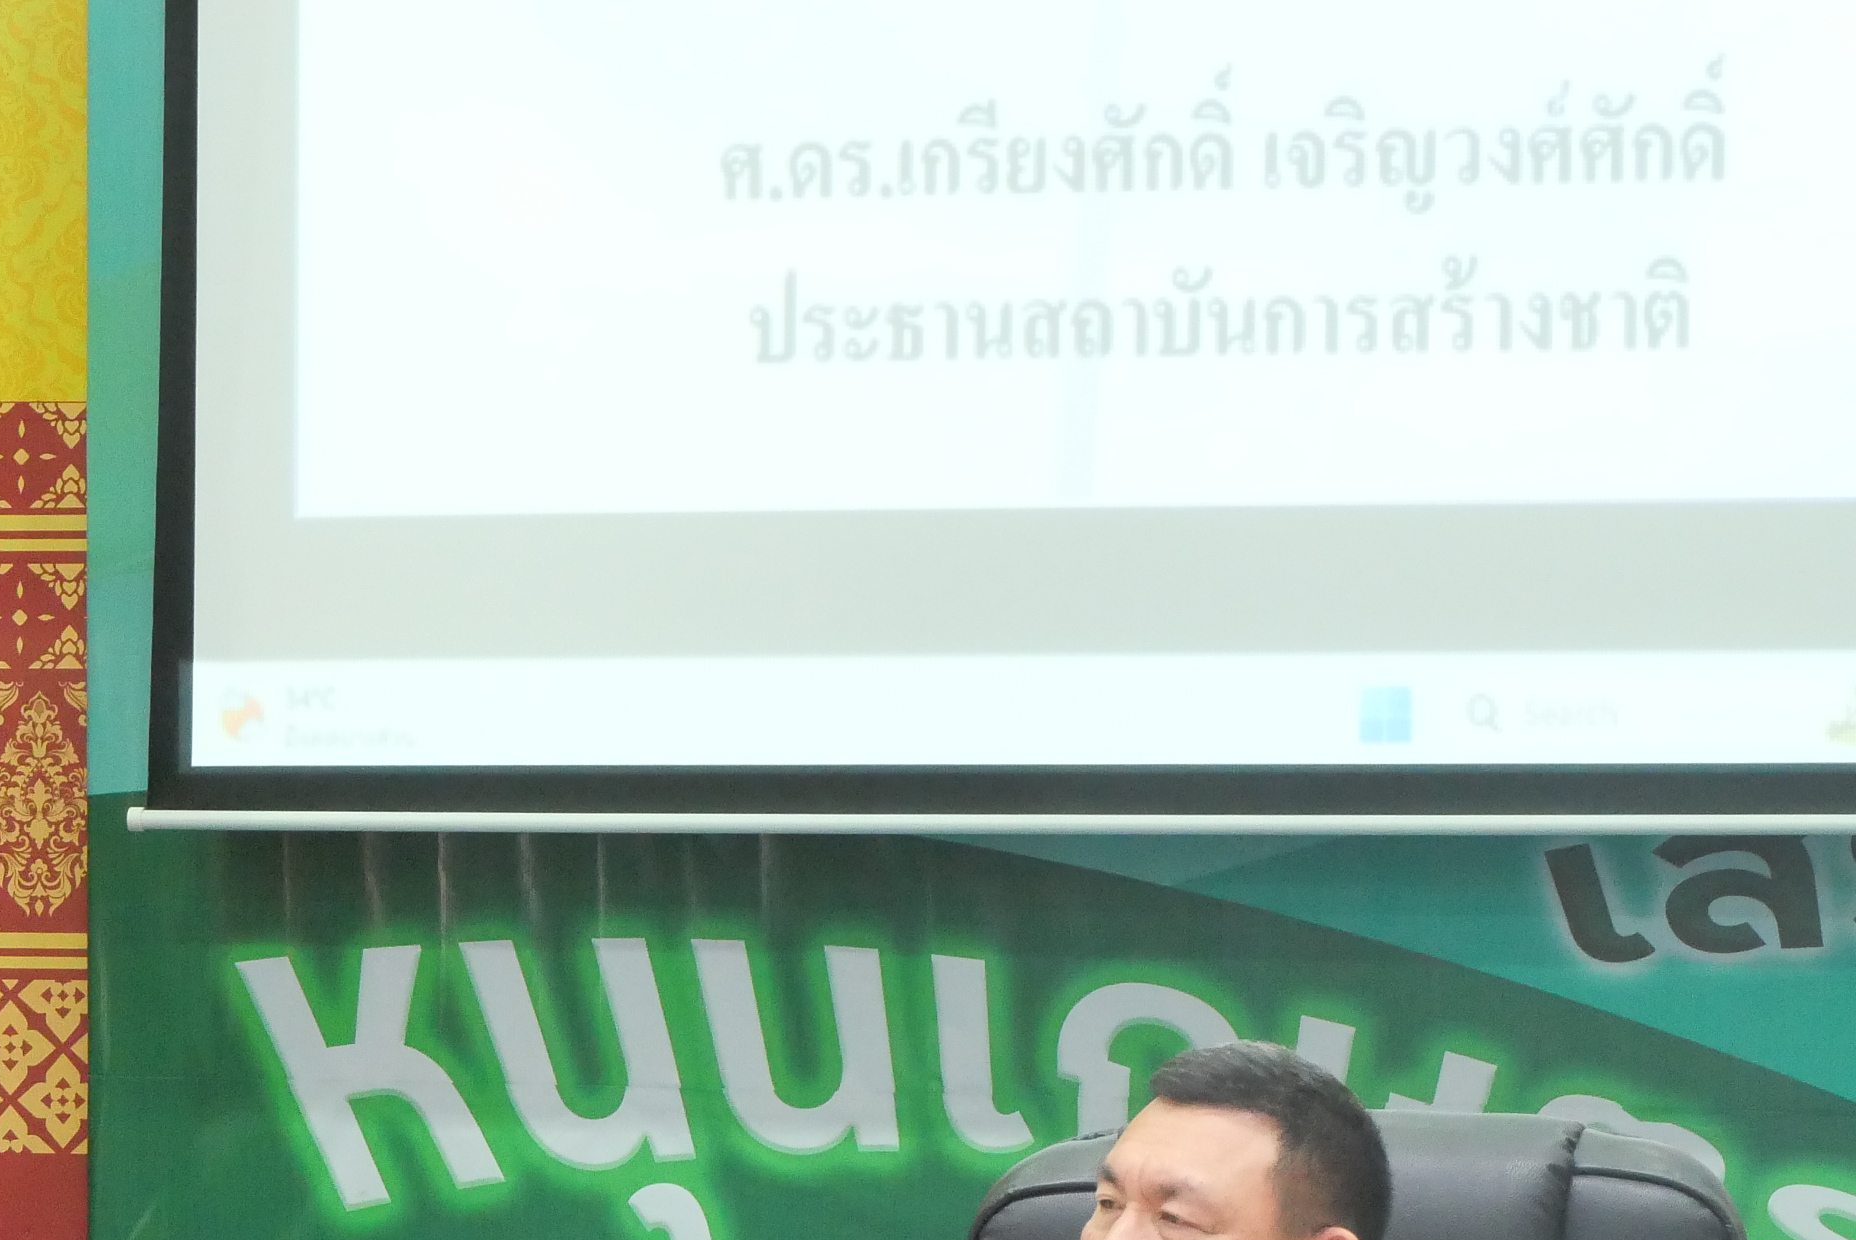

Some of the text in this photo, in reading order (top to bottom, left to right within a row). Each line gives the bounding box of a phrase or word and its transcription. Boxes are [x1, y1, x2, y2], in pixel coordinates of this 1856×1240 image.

[719, 50, 1728, 216] ศ.ดร.เกรียงศักดิ์ เจริญวงศ์ศักดิ์
[747, 254, 1692, 365] ประธานสถาบันการสร้างชาติ
